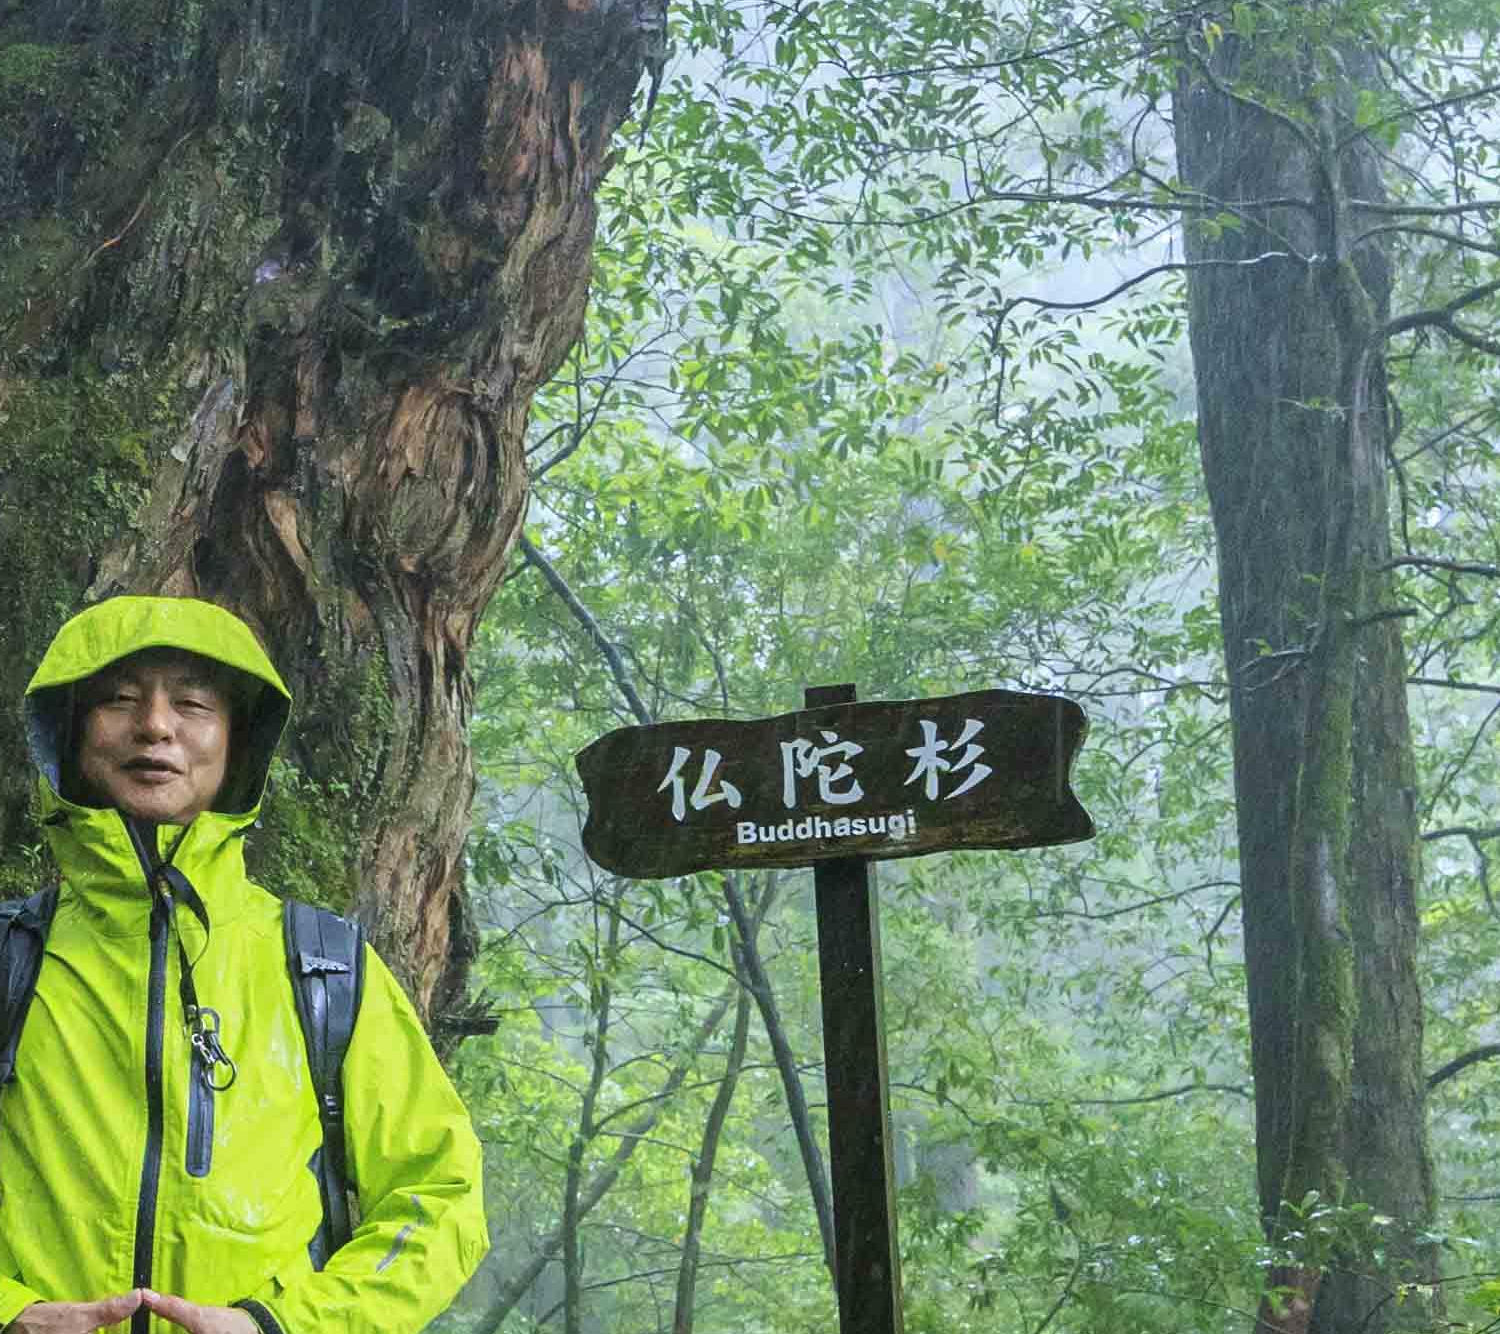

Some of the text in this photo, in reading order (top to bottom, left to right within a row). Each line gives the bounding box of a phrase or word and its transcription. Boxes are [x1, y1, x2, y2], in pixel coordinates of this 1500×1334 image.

[657, 718, 993, 822] 仏陀杉
[736, 809, 917, 846] Buddhasugi
